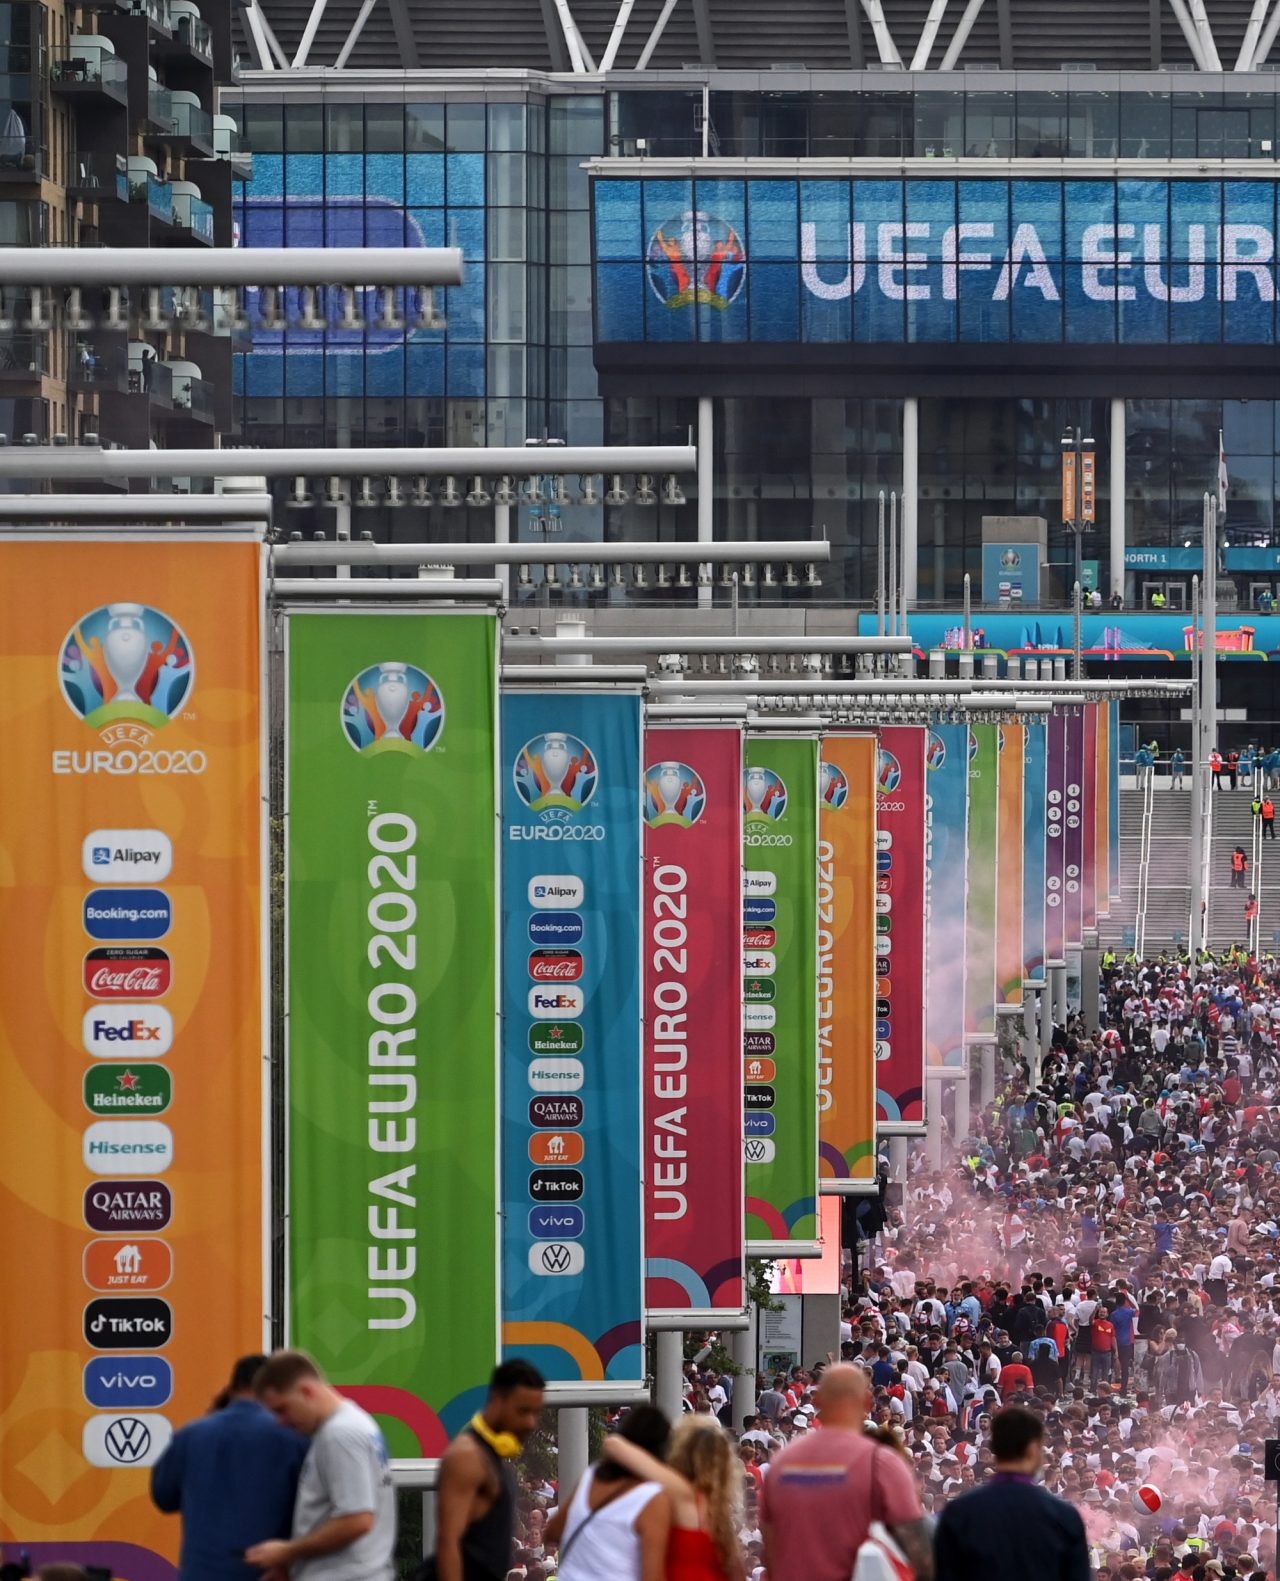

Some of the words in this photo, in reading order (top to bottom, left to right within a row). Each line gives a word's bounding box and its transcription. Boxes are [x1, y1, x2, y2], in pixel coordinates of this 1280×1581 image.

[801, 221, 1060, 301] UEFA
[102, 728, 149, 745] UEFA
[52, 750, 208, 774] EURO2020
[540, 811, 570, 822] UEFA
[509, 825, 605, 841] EURO2020
[113, 848, 161, 864] Alipay
[750, 879, 771, 888] Alipay
[367, 812, 417, 970] 2020
[547, 887, 577, 897] Alipay
[87, 907, 167, 921] Booking.com
[653, 864, 688, 973] 2020
[531, 921, 581, 933] Booking.com
[535, 995, 576, 1008] FedEx
[93, 1020, 160, 1041] FedEx
[534, 1041, 577, 1049] Heineken
[654, 981, 688, 1099] EURO
[367, 982, 417, 1152] EURO
[532, 1070, 580, 1080] Hisense
[93, 1093, 162, 1107] Heineken
[747, 1094, 772, 1102] TikTok
[534, 1102, 577, 1115] QATAR
[89, 1142, 167, 1154] Hisense
[654, 1106, 688, 1220] UEFA
[544, 1181, 580, 1190] TikTok
[92, 1192, 162, 1211] QATAR
[109, 1209, 163, 1220] AIRWAYS
[539, 1215, 574, 1226] vivo
[368, 1164, 416, 1329] UEFA
[107, 1275, 130, 1285] JUST
[130, 1275, 148, 1284] EAT
[109, 1318, 165, 1332] TikTok
[100, 1372, 156, 1388] vivo
